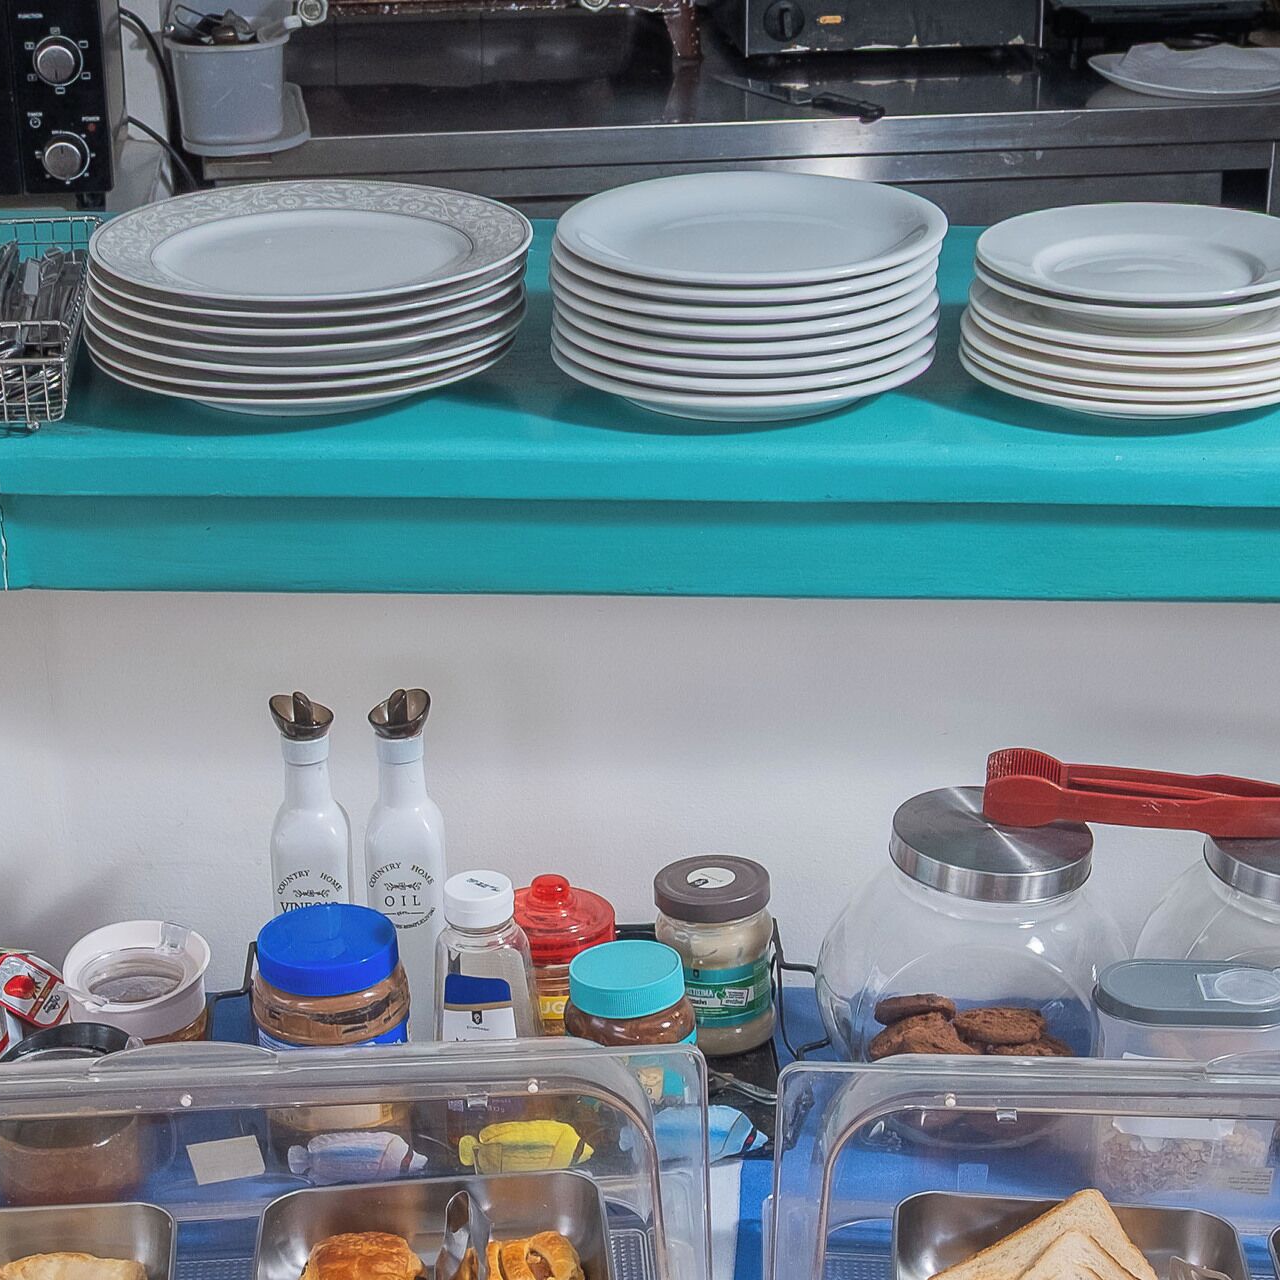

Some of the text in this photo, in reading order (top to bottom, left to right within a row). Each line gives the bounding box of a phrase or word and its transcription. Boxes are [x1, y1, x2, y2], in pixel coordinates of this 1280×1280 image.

[276, 869, 342, 895] COUNTRY HOME
[366, 862, 434, 888] COUNTRY HOME
